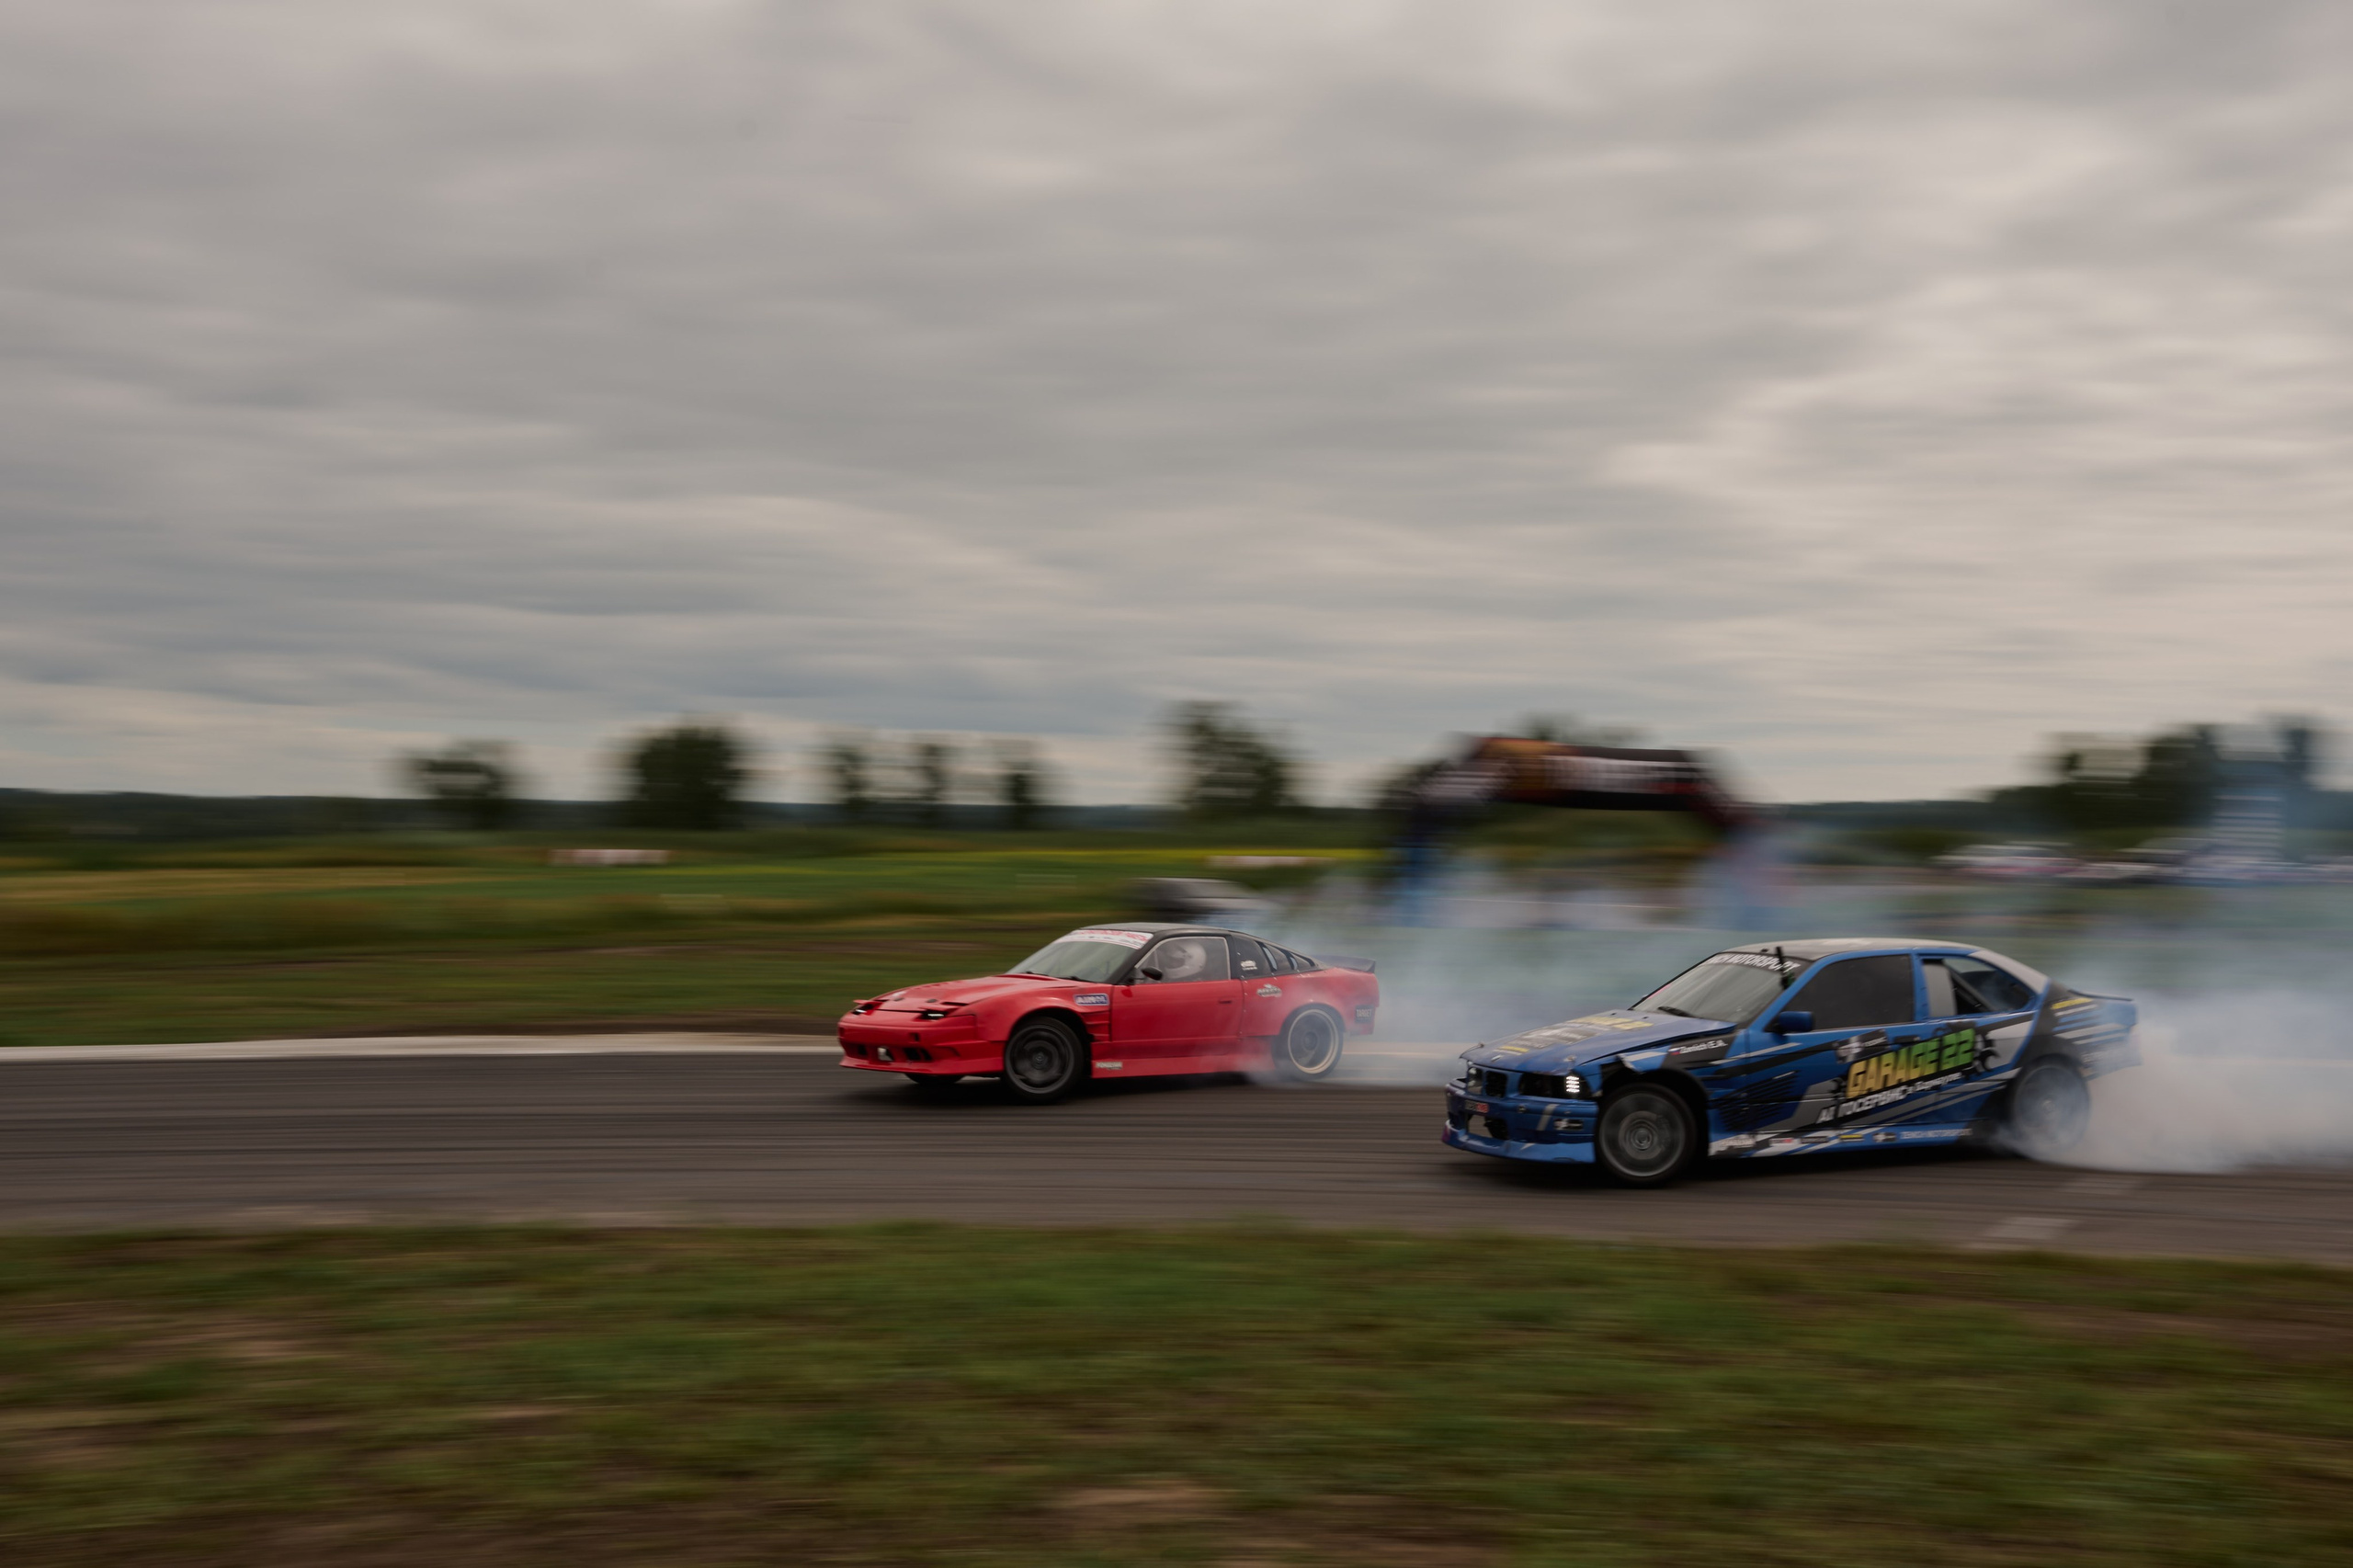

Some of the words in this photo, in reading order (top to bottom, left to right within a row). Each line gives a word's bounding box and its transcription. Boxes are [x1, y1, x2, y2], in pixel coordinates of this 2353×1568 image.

[1356, 1008, 1372, 1017] TARGET
[1847, 1038, 1939, 1098] GARAGE
[1941, 1028, 1975, 1071] 22
